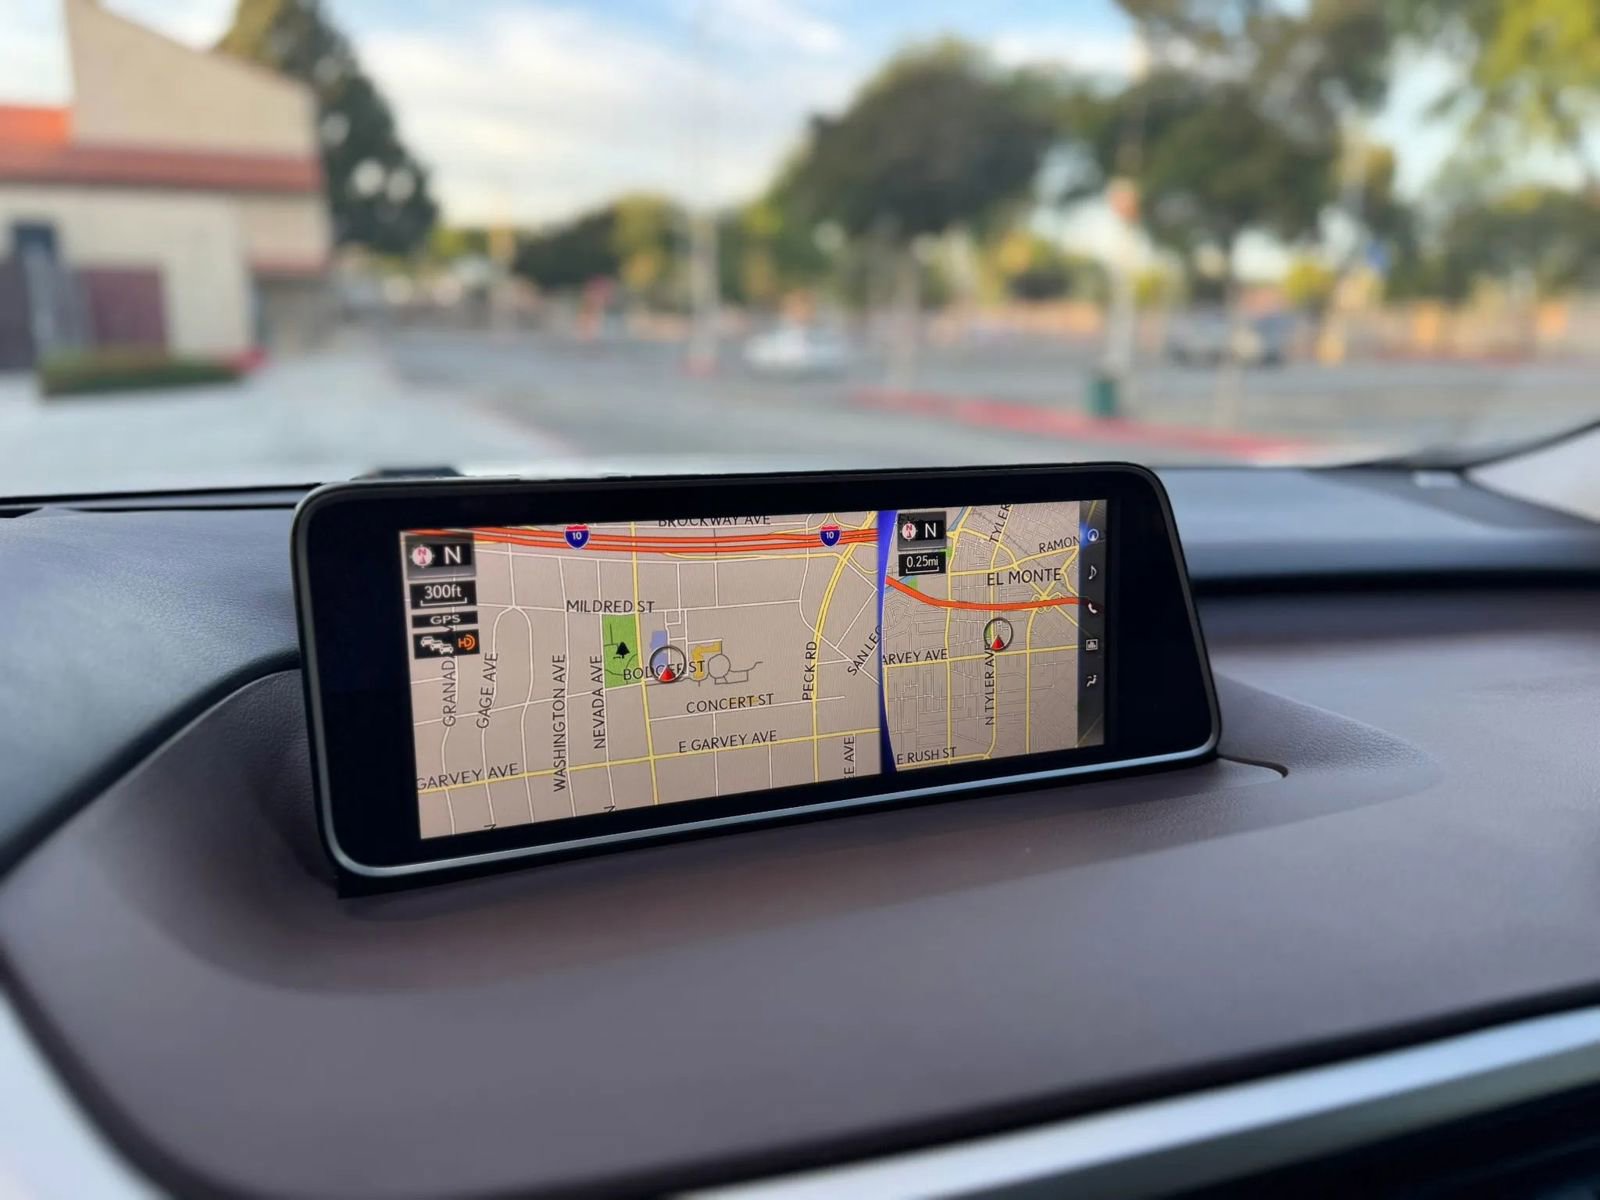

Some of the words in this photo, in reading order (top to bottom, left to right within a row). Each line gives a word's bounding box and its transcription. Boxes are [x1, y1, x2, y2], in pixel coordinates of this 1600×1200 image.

[658, 517, 738, 527] BROCKWAY
[745, 516, 771, 525] AVE
[925, 523, 936, 538] N
[989, 503, 1011, 543] TYLER
[572, 532, 582, 541] 10
[444, 546, 461, 564] N
[907, 556, 939, 567] 0.25mi
[987, 573, 1004, 586] EL
[1008, 568, 1062, 584] MONTE
[424, 585, 462, 599] 300ft
[567, 600, 633, 613] MILDRED
[637, 600, 655, 612] ST
[430, 615, 461, 624] GPS
[805, 641, 817, 660] RD
[925, 649, 948, 661] AVE
[985, 645, 995, 667] AVE
[483, 652, 498, 682] AVE
[552, 655, 566, 683] AVE
[590, 656, 602, 682] AVE
[689, 660, 705, 672] ST
[848, 650, 868, 676] SAN
[442, 656, 456, 727] GRANAD
[802, 663, 815, 700] PECK
[985, 672, 995, 712] TYLER
[477, 687, 494, 728] GAGE
[686, 695, 754, 713] CONCERT
[758, 693, 774, 705] ST
[593, 684, 606, 748] NEVADA
[553, 685, 568, 792] WASHINGTON
[679, 741, 686, 753] E
[691, 733, 747, 751] GARVEY
[751, 730, 777, 743] AVE
[844, 736, 854, 762] AVE
[897, 754, 903, 764] E
[908, 749, 939, 762] RUSH
[943, 747, 956, 758] ST
[417, 769, 482, 790] GARVEY
[488, 763, 519, 779] AVE
